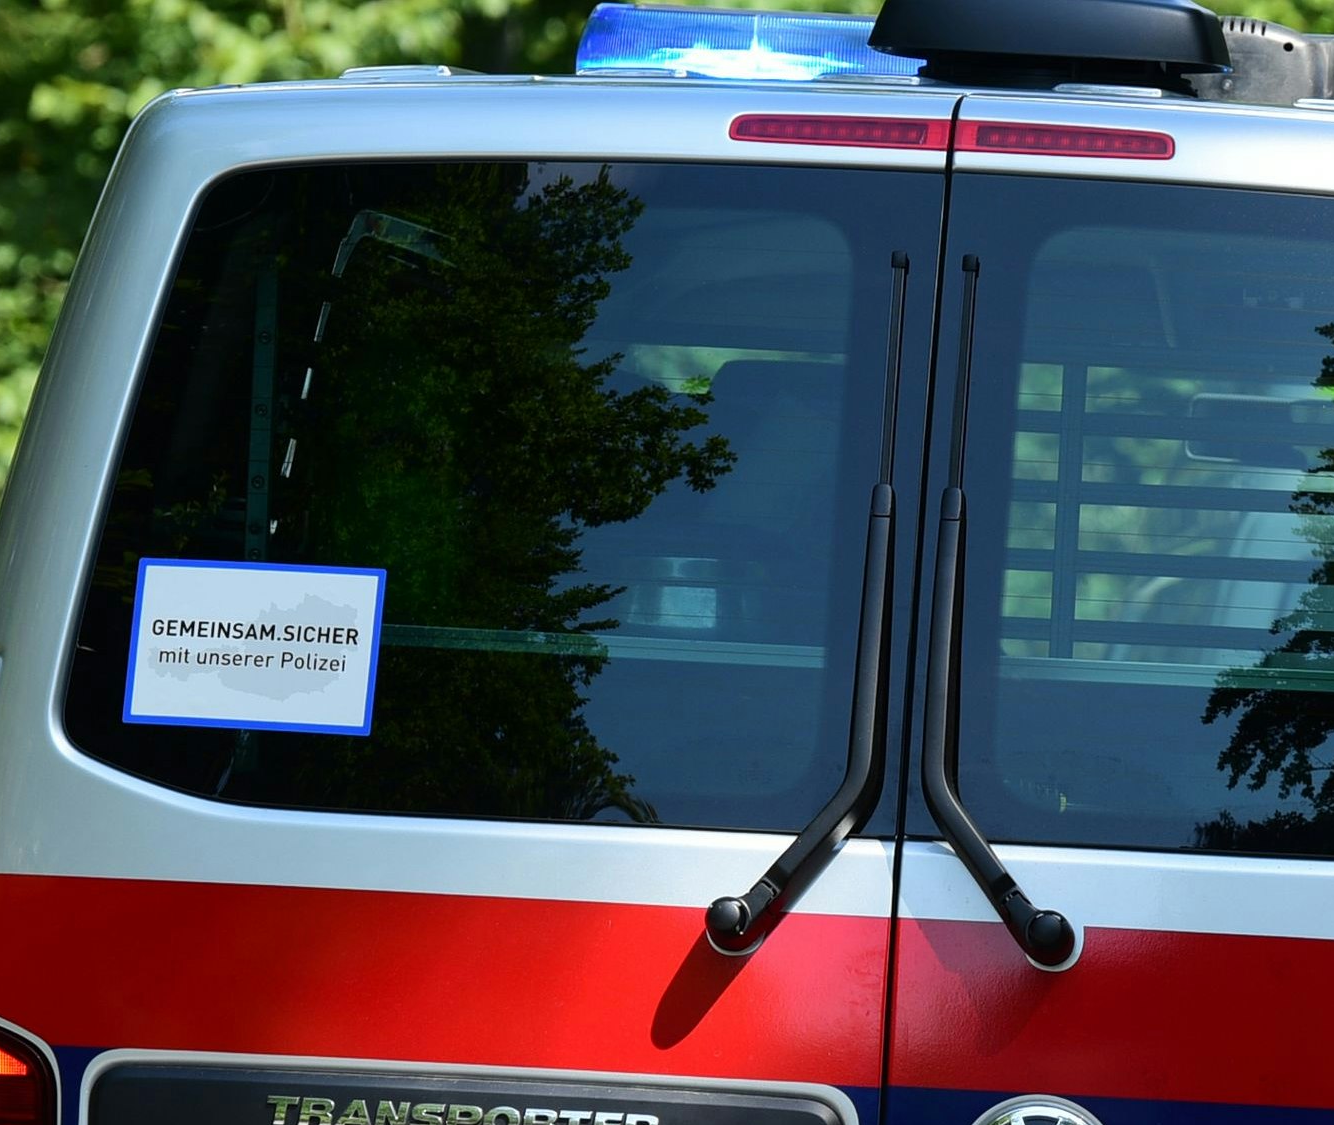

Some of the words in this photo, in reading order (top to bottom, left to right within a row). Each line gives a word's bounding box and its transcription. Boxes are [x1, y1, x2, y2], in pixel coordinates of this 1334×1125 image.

[151, 618, 360, 646] GEMEINSAM.SICHER
[158, 647, 190, 665] mit
[196, 651, 275, 669] unserer
[280, 652, 347, 673] Polizei
